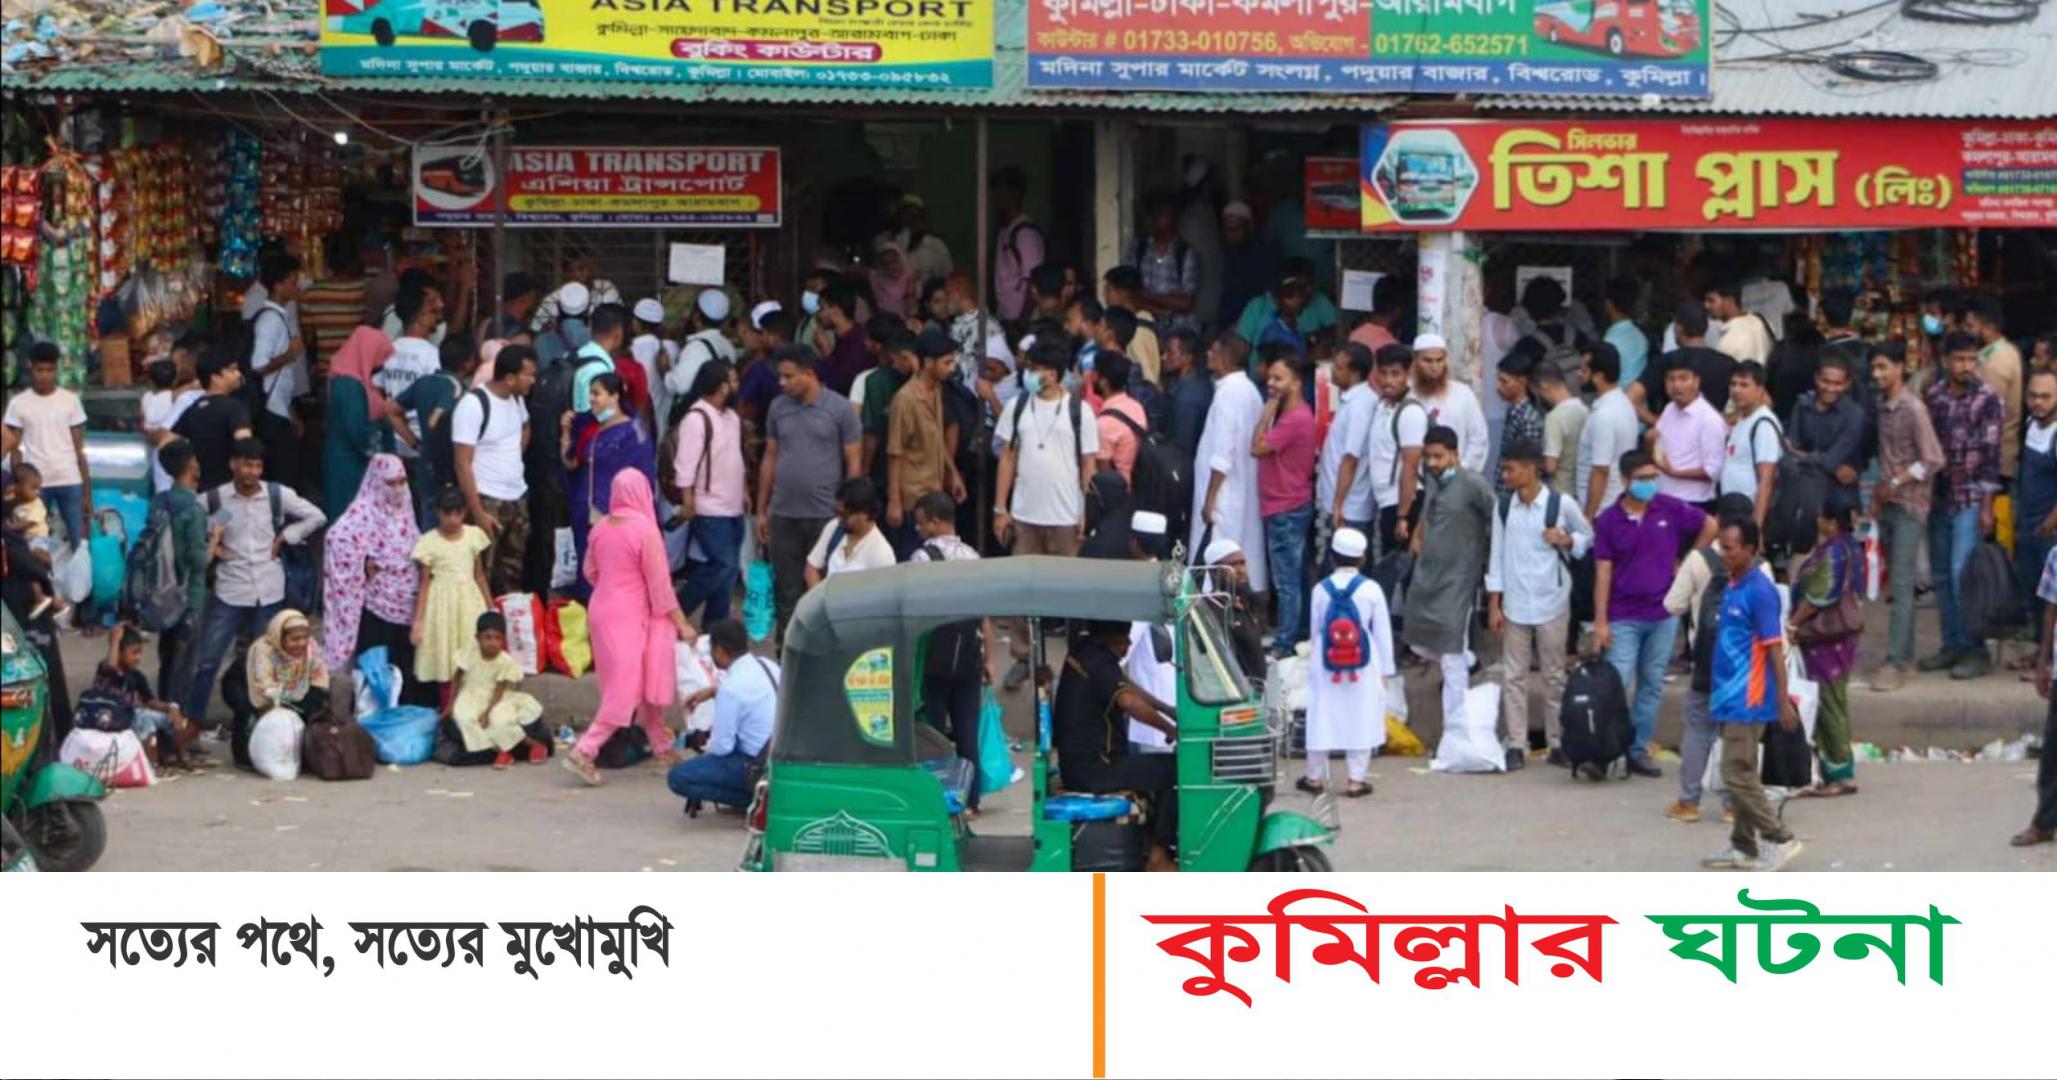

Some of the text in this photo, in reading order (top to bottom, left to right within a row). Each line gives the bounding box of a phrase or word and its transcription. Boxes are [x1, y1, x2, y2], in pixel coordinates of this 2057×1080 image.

[678, 37, 749, 60] বুকিং
[1375, 33, 1530, 55] 01762-652571
[1039, 57, 1104, 77] মদিনা
[1111, 60, 1170, 80] সুপার
[1178, 58, 1250, 78] মার্কেট
[507, 152, 765, 172] ASIA TRANSPORT
[1489, 129, 1668, 210] তিশা
[1696, 150, 1838, 220] প্লাস
